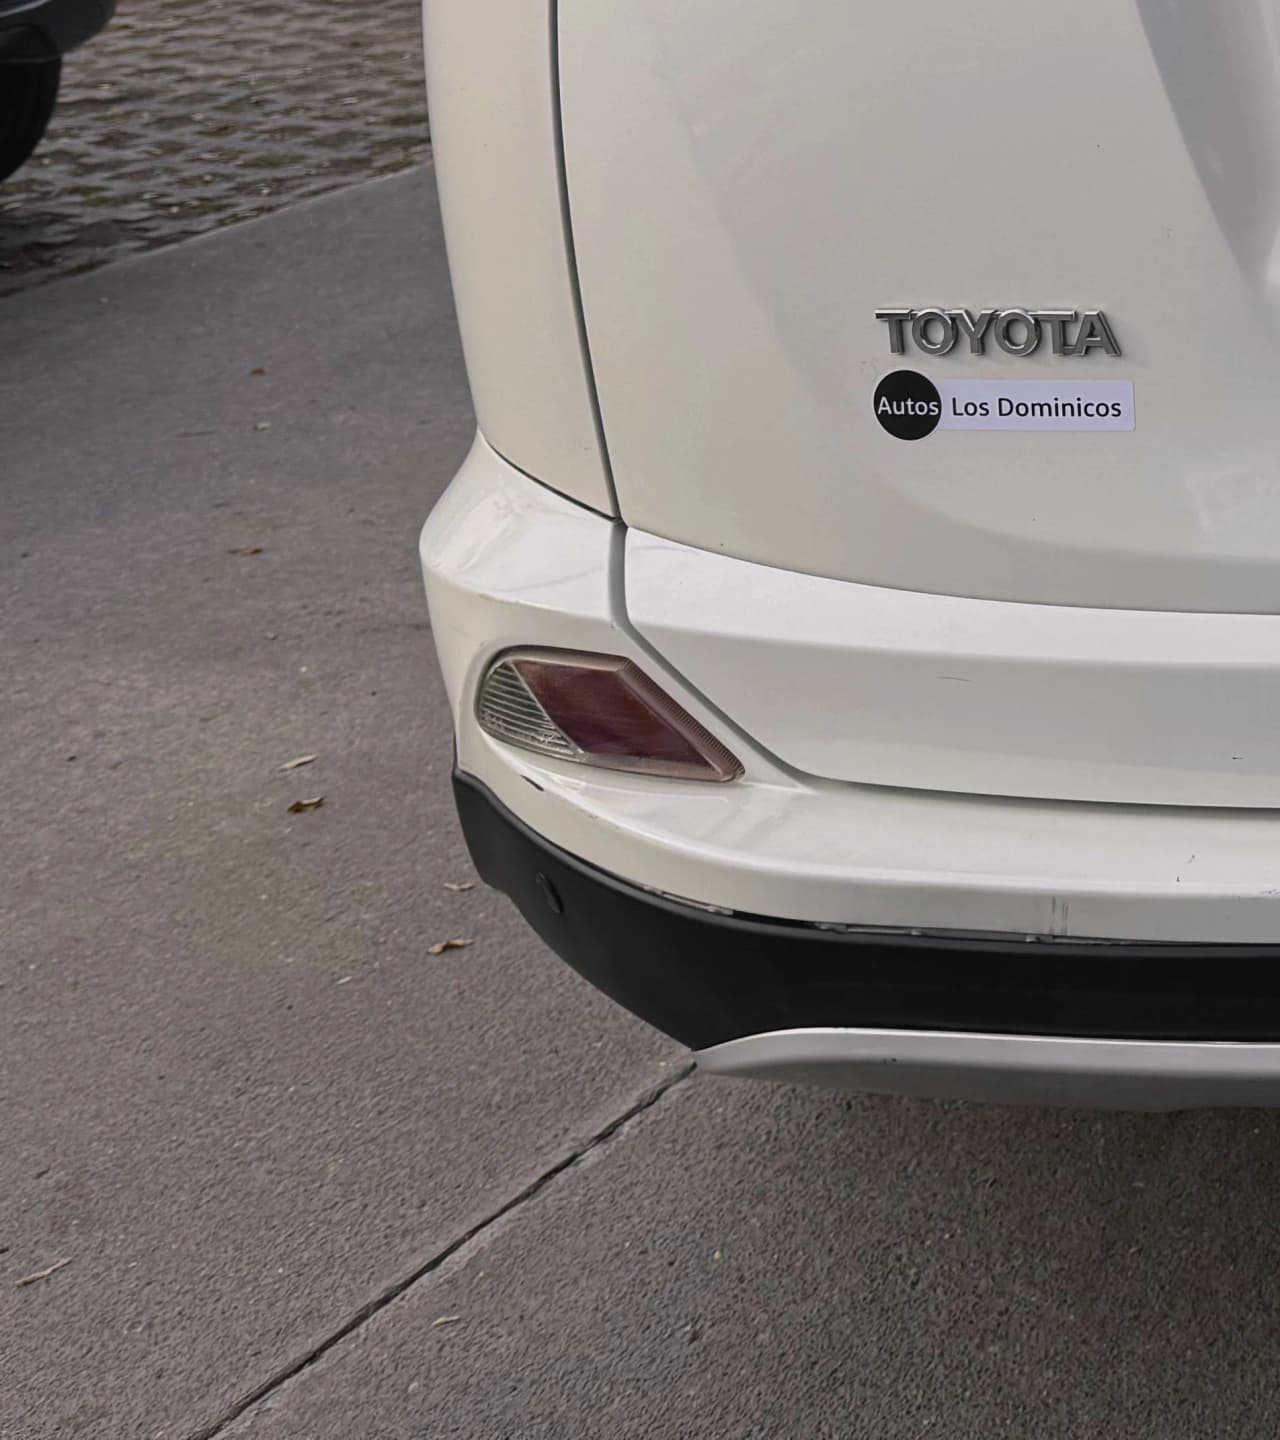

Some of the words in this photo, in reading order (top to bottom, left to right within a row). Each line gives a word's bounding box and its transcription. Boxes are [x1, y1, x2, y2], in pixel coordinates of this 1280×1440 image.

[875, 309, 1121, 357] TOYOTA
[877, 396, 940, 416] Autos
[952, 397, 990, 417] Los
[998, 398, 1122, 418] Dominicos
